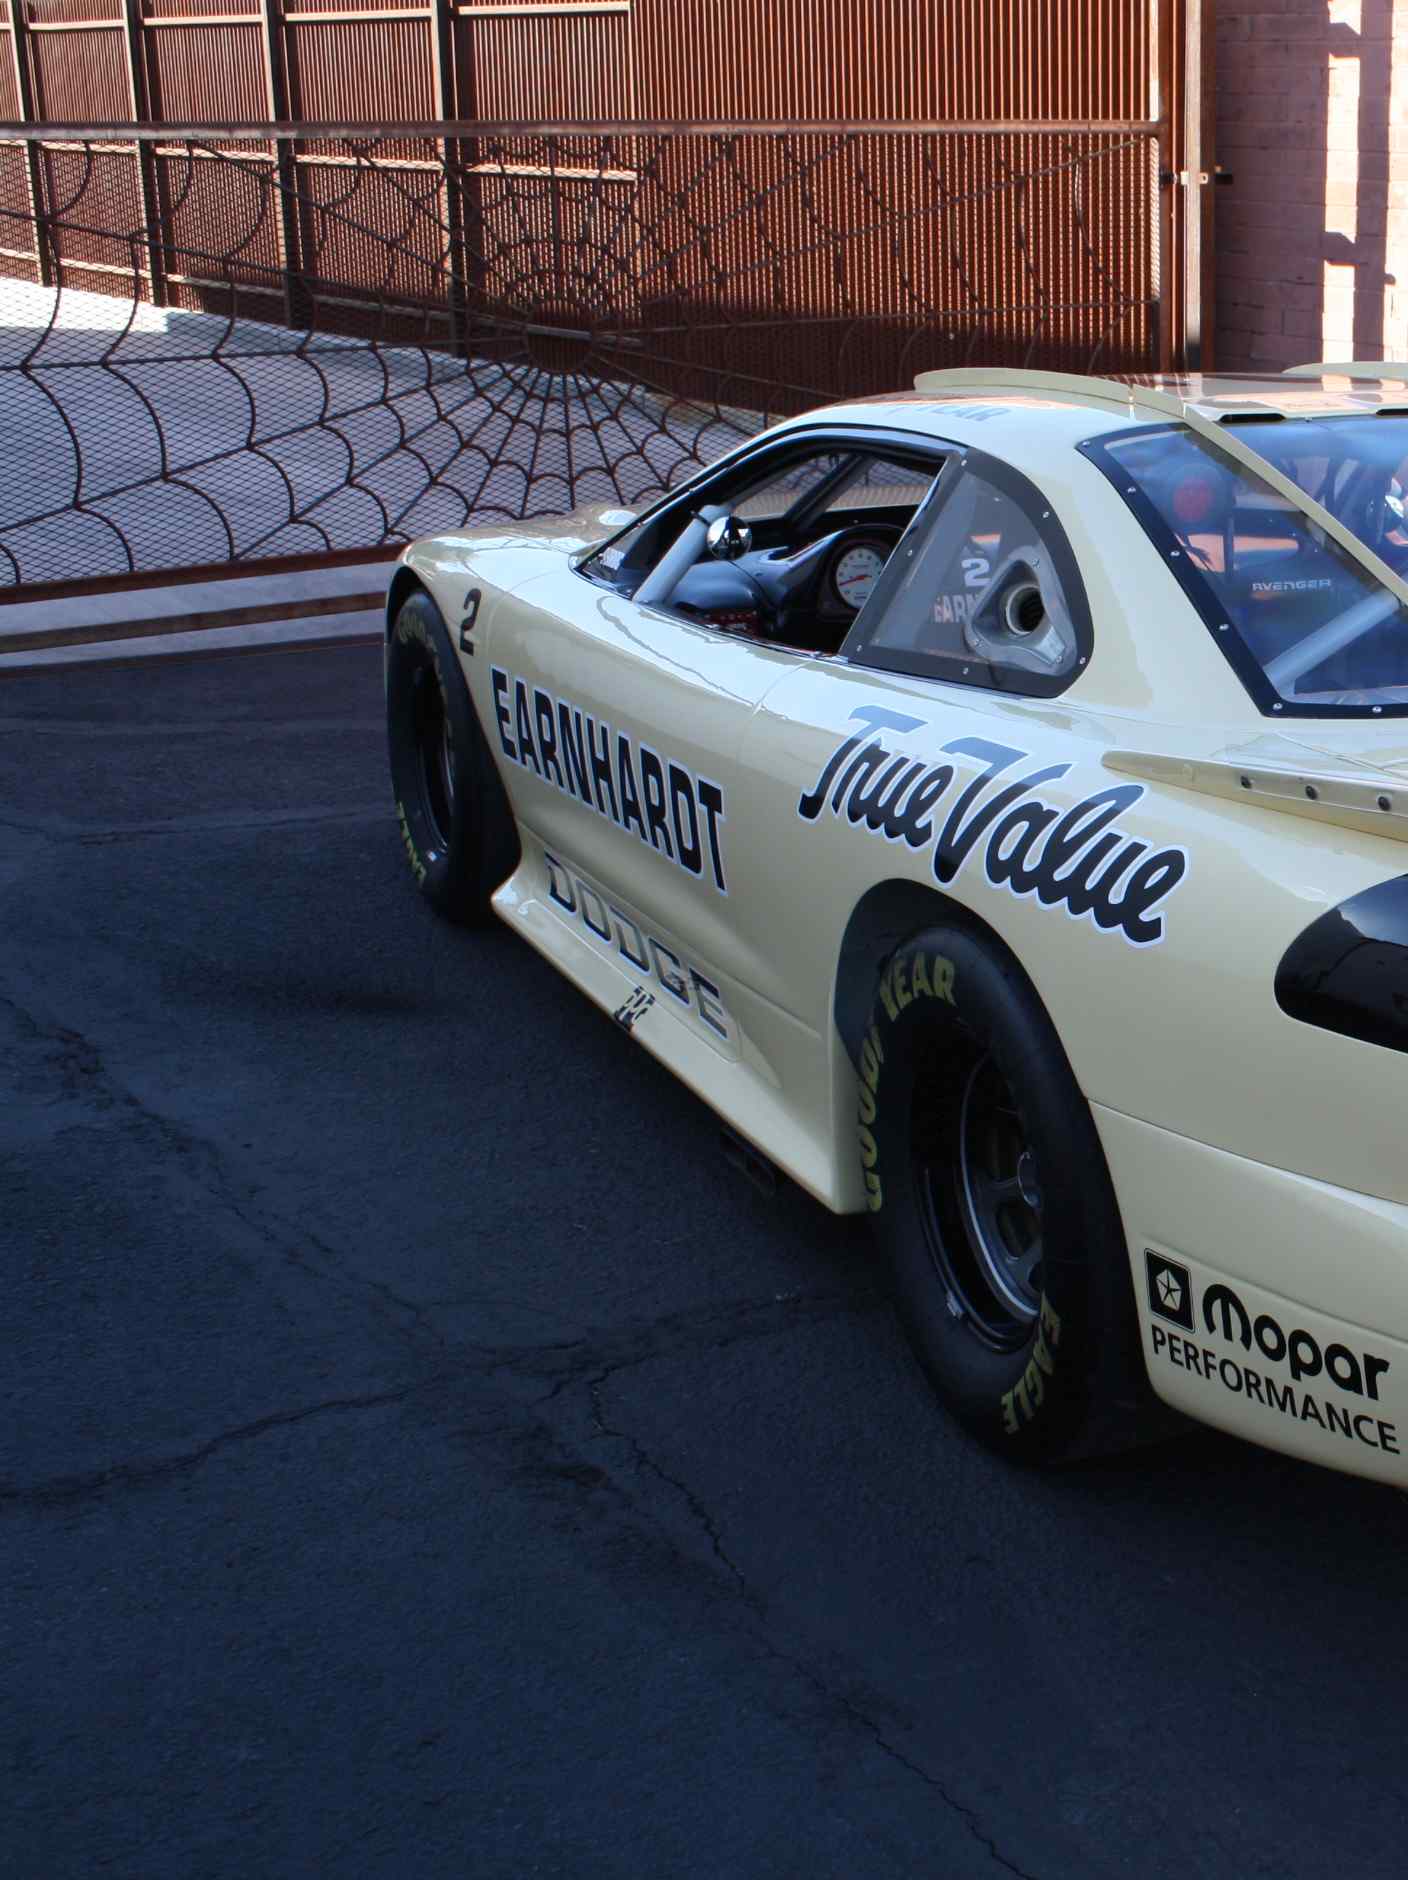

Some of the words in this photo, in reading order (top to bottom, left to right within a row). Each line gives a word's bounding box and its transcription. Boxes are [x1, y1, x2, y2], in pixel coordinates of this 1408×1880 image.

[460, 587, 482, 656] 2
[1252, 579, 1331, 591] AVENGER
[489, 663, 728, 896] EARNHARDT
[796, 704, 957, 852] True
[931, 736, 1190, 949] Value
[544, 848, 729, 1039] DODGE
[1151, 1324, 1401, 1455] PERFORMANCE
[1202, 1284, 1390, 1401] Mopar
